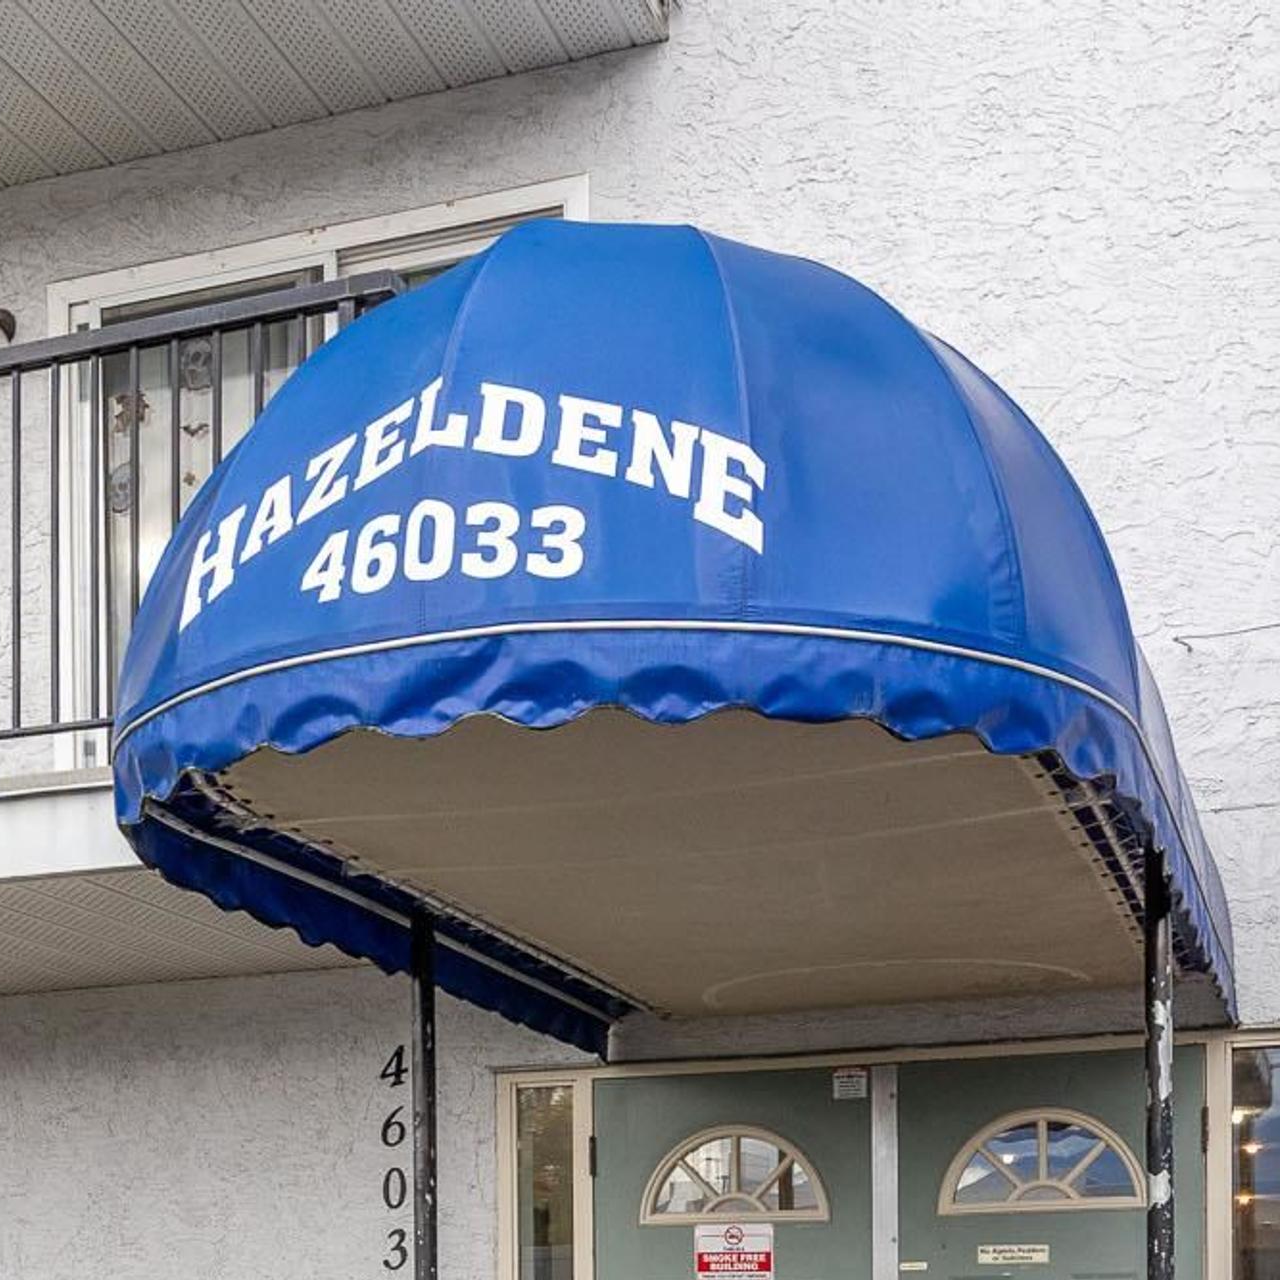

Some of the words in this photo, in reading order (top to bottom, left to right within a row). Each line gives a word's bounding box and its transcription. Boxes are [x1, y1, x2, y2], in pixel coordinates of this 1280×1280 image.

[180, 376, 767, 632] HAZELDENE
[301, 499, 588, 603] 46033
[702, 1253, 738, 1262] SMOKE
[740, 1253, 766, 1262] FREE
[710, 1262, 758, 1271] BUILDING
